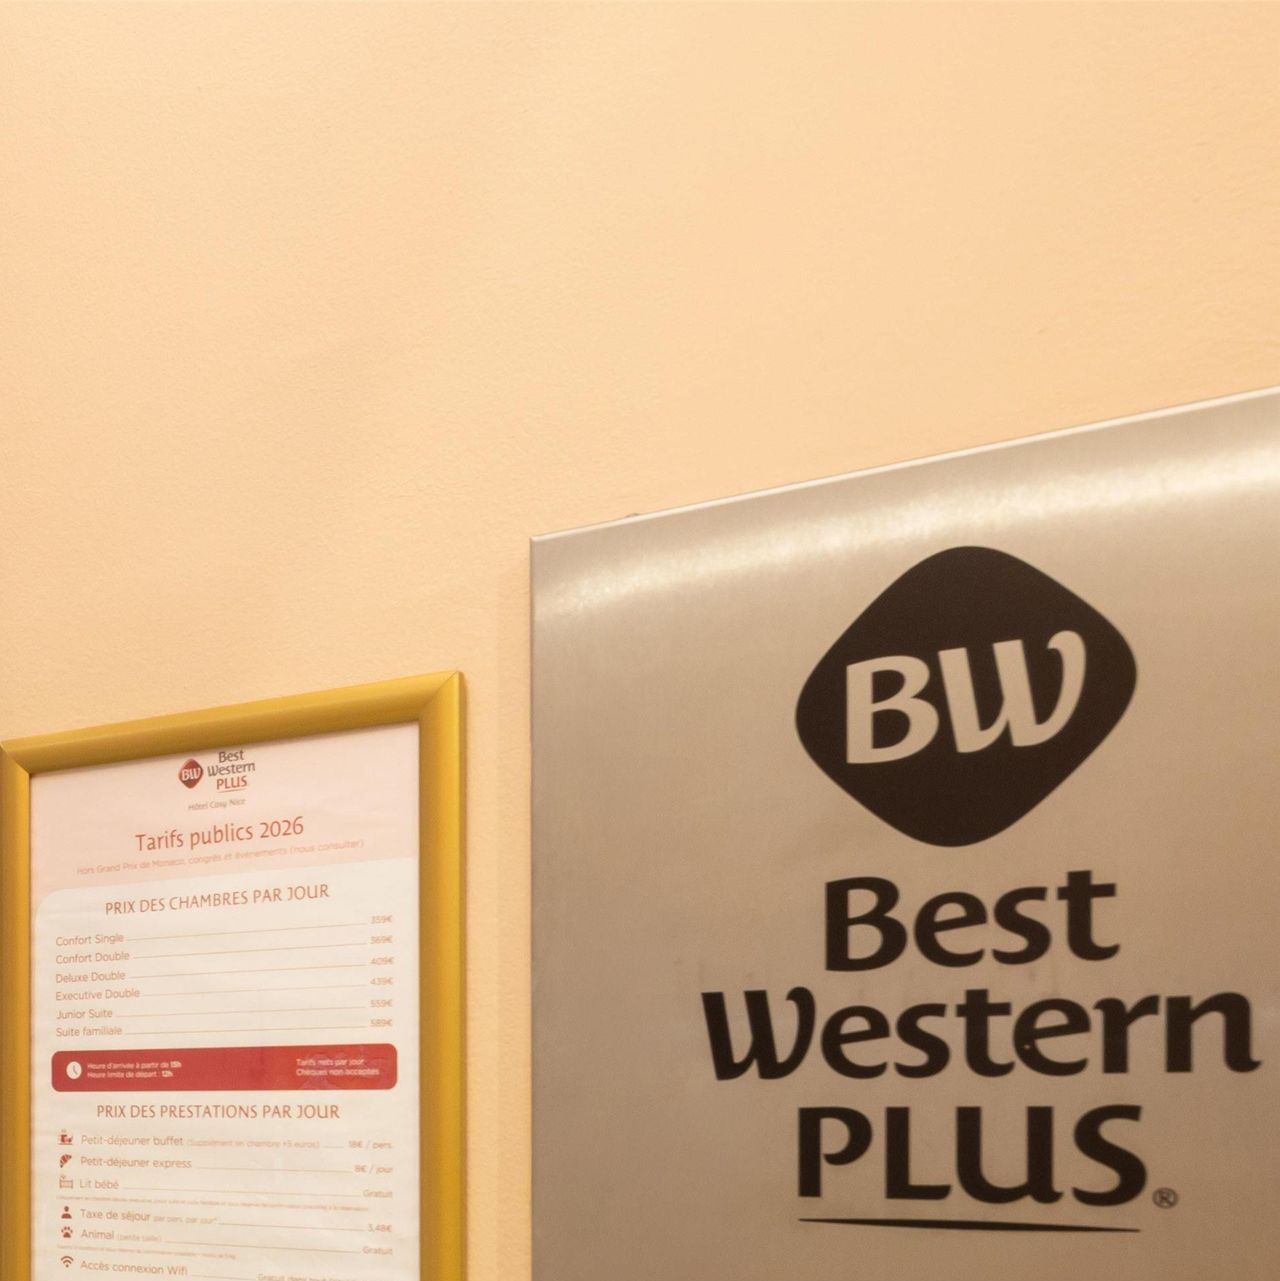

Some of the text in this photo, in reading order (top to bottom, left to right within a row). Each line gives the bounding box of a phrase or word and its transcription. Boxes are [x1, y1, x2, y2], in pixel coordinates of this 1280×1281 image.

[846, 630, 1087, 764] BW
[218, 750, 244, 763] Best
[182, 768, 201, 781] BW
[207, 762, 256, 776] Western
[216, 776, 248, 790] PLUS
[135, 816, 304, 851] Tarifs publics 2026
[105, 884, 329, 915] PRIX DES CHAMBRES PAR JOUR
[825, 869, 1120, 972] Best
[56, 932, 124, 947] Confort Single
[56, 950, 130, 966] Confort Double
[56, 970, 126, 984] Deluxe Double
[56, 988, 140, 1002] Executive Double
[56, 1008, 113, 1020] Junior Suite
[56, 1025, 122, 1038] Suite familiale
[701, 986, 1263, 1081] Western
[96, 1104, 340, 1120] PRIX DES PRESTATIONS PAR JOUR
[80, 1134, 151, 1148] Petit-déjeuner
[153, 1136, 184, 1146] buffet
[80, 1156, 192, 1170] Petit-déjeuner express
[80, 1178, 119, 1190] Lit bébé
[80, 1208, 103, 1219] Taxe
[106, 1210, 118, 1220] de
[121, 1211, 151, 1222] séjour
[81, 1229, 114, 1240] Animal
[80, 1260, 188, 1276] Accès connexion Wifi
